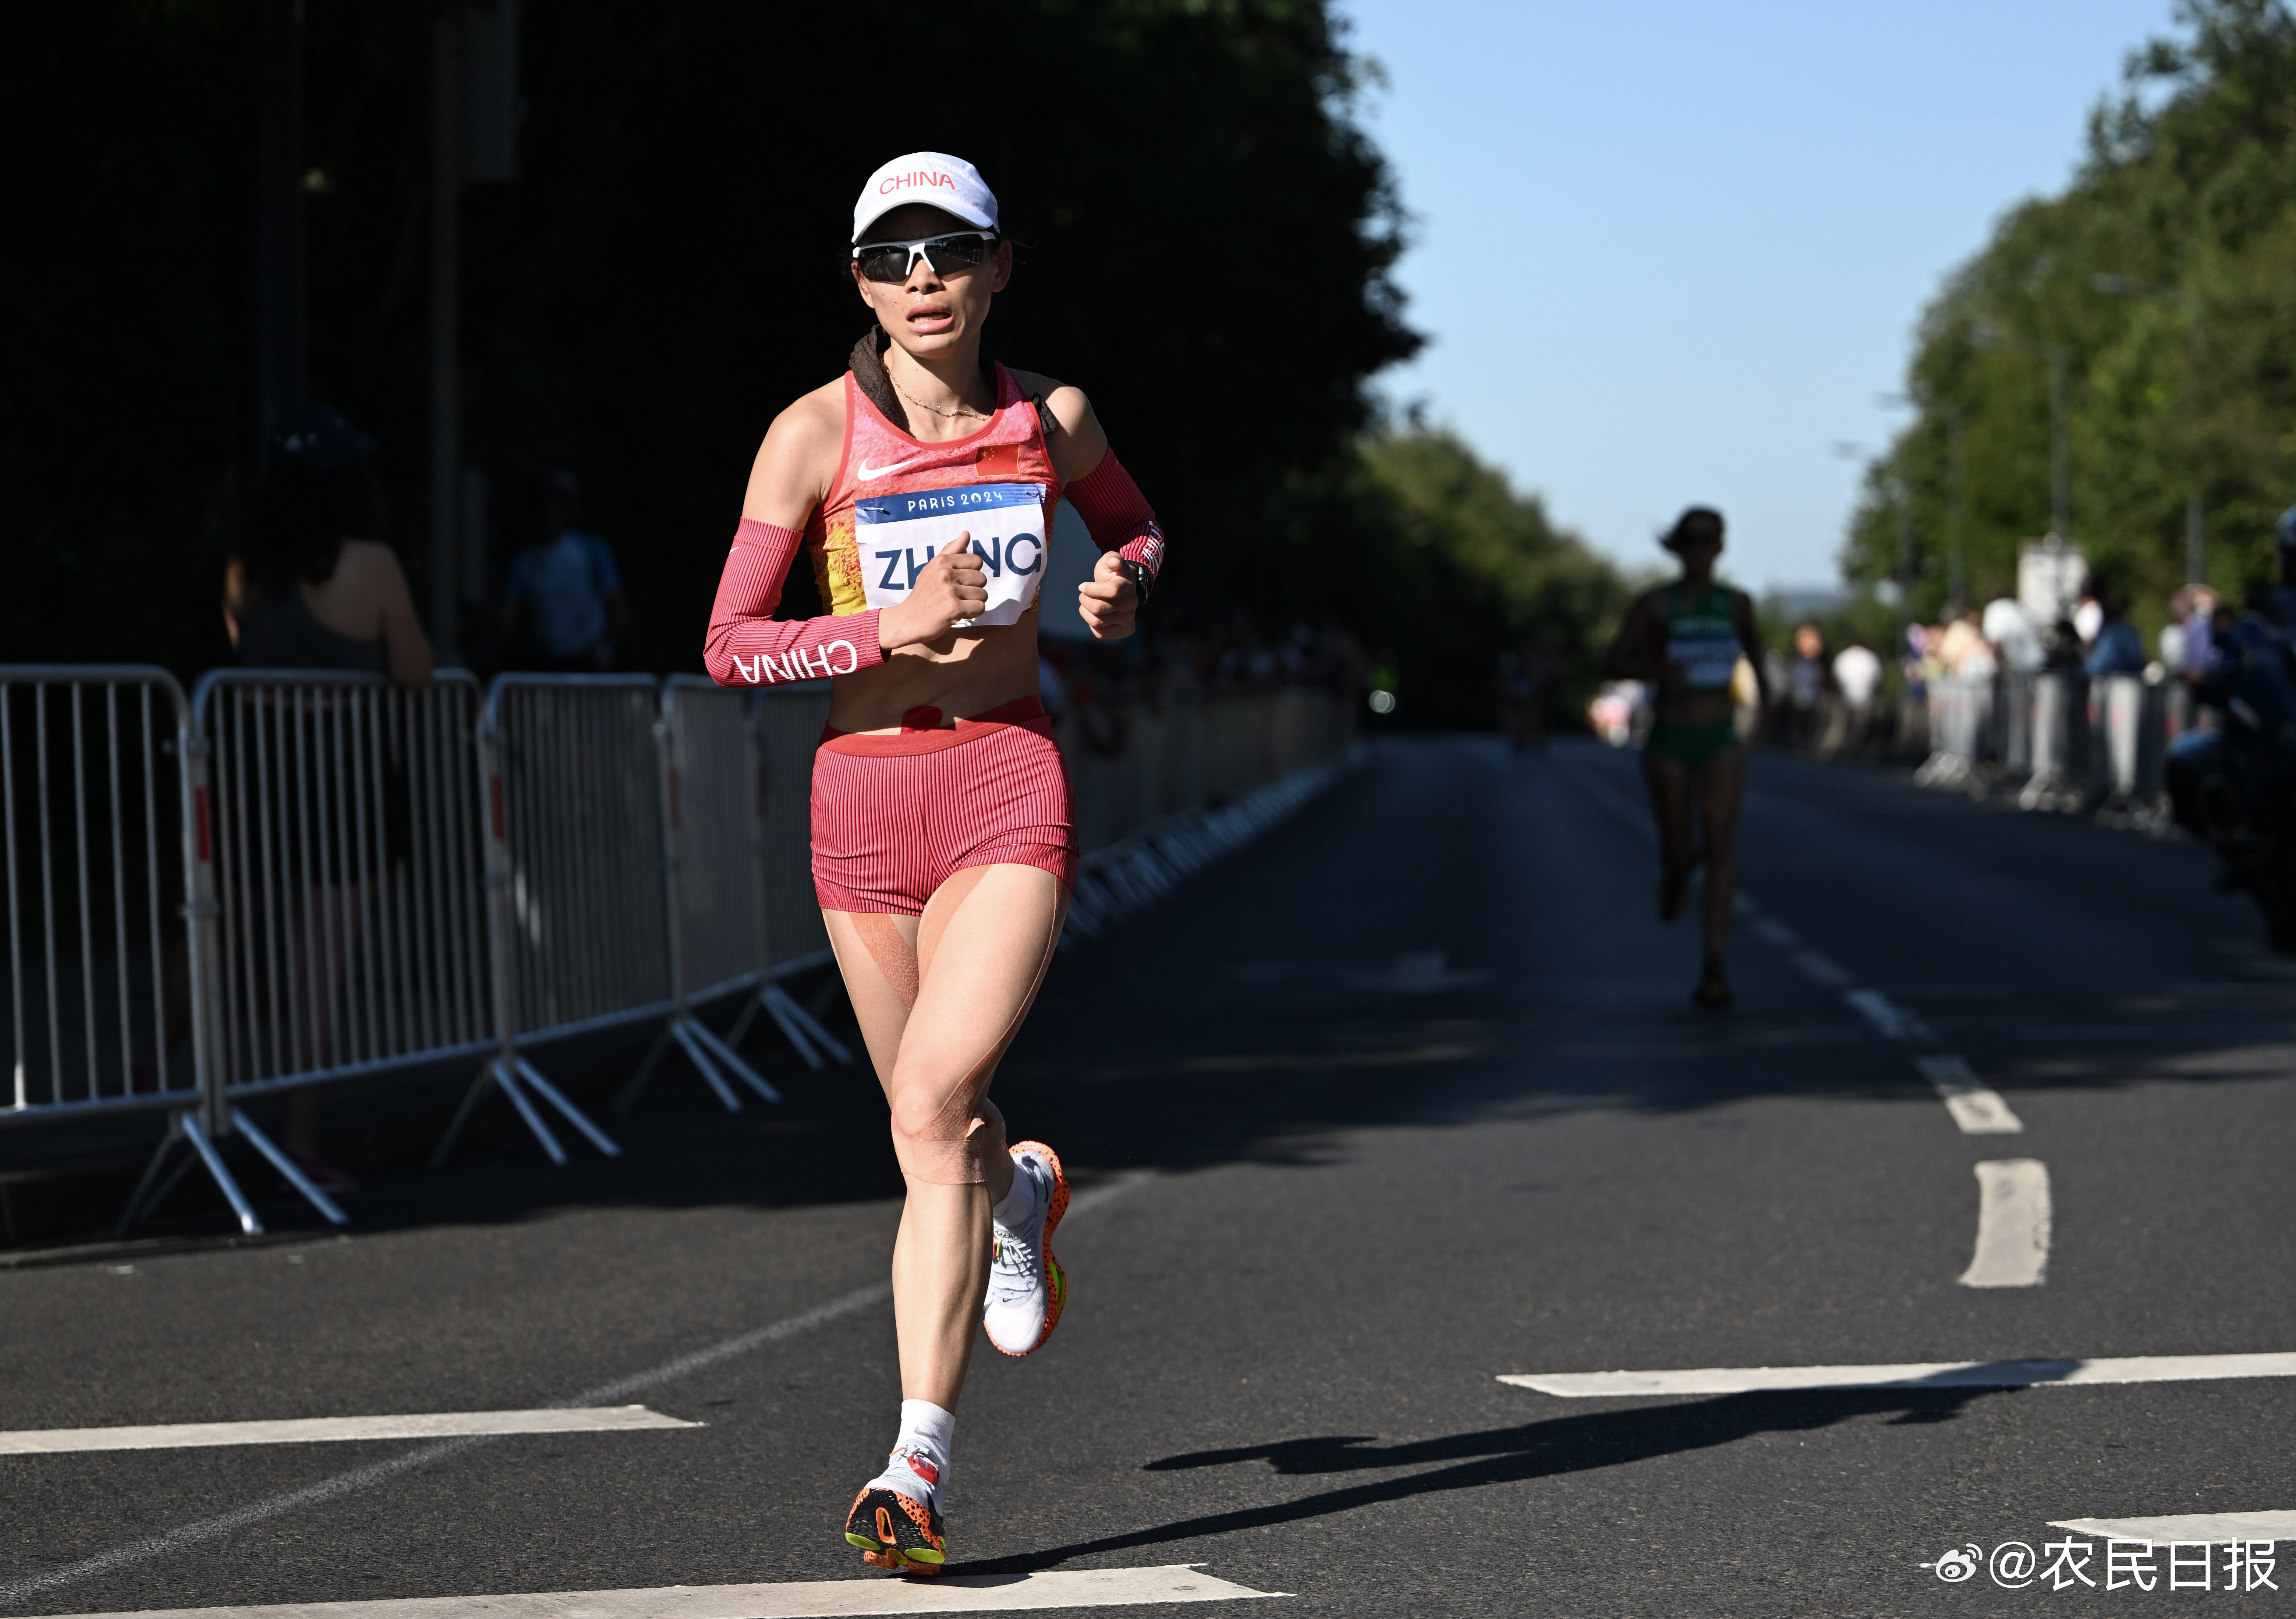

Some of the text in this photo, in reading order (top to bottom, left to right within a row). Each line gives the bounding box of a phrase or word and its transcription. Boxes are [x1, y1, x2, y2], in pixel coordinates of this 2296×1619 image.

[879, 171, 956, 195] CHINA
[960, 491, 1003, 505] 2024
[875, 532, 1042, 590] ZHNG
[733, 639, 857, 684] CHINA
